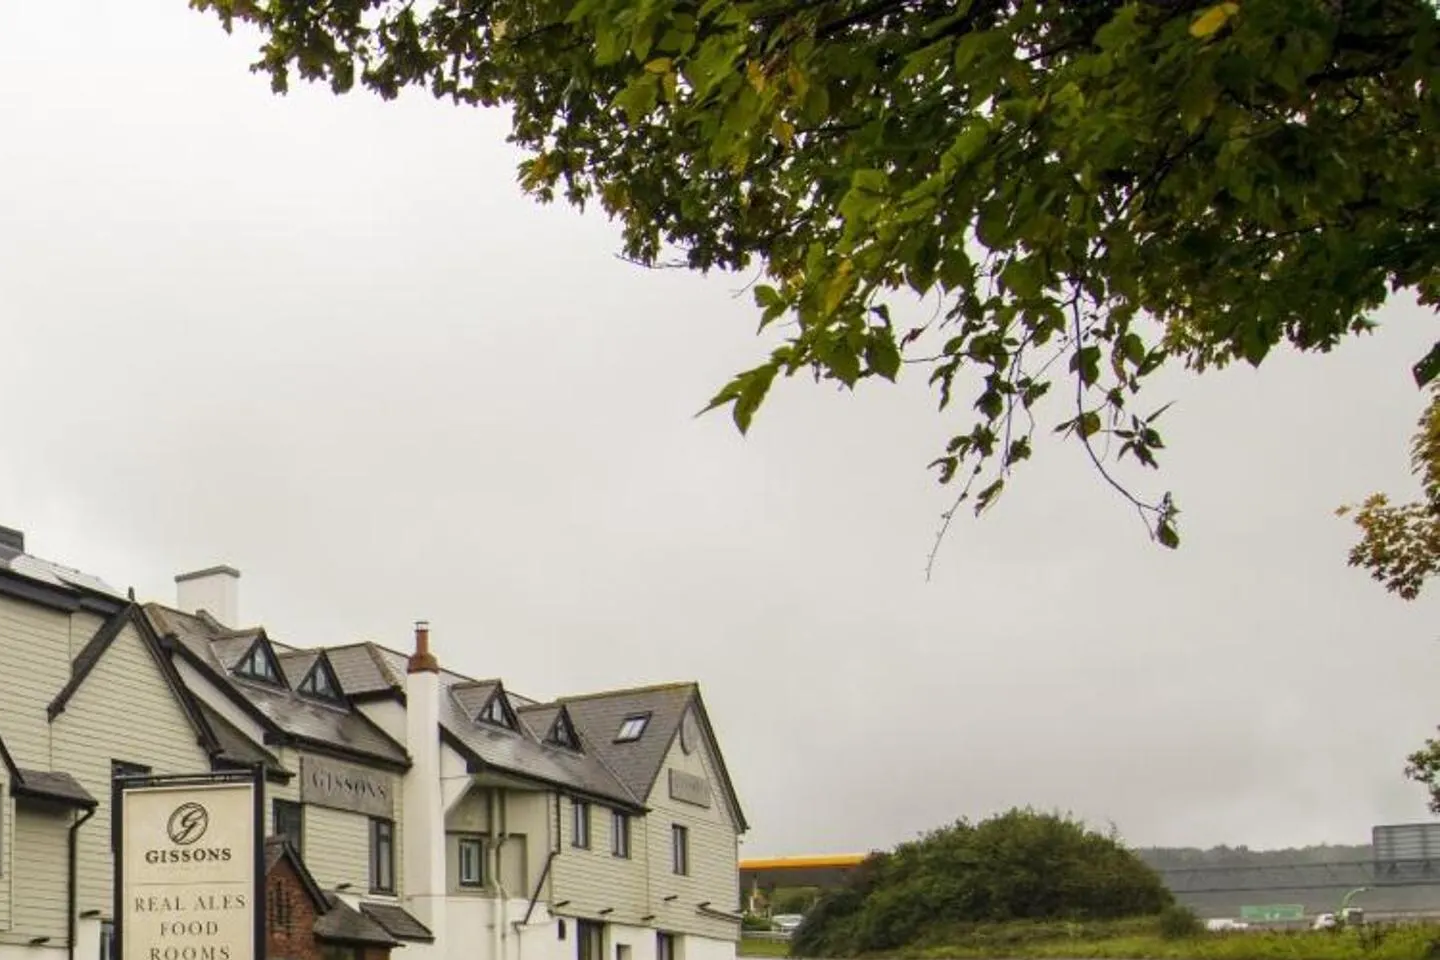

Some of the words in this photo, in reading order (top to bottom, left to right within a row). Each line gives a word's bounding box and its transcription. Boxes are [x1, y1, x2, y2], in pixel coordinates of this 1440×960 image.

[145, 848, 232, 864] GISSONS
[135, 896, 186, 912] REAL
[194, 894, 245, 910] ALES
[160, 921, 218, 936] FOOD
[150, 945, 229, 960] ROOMS
